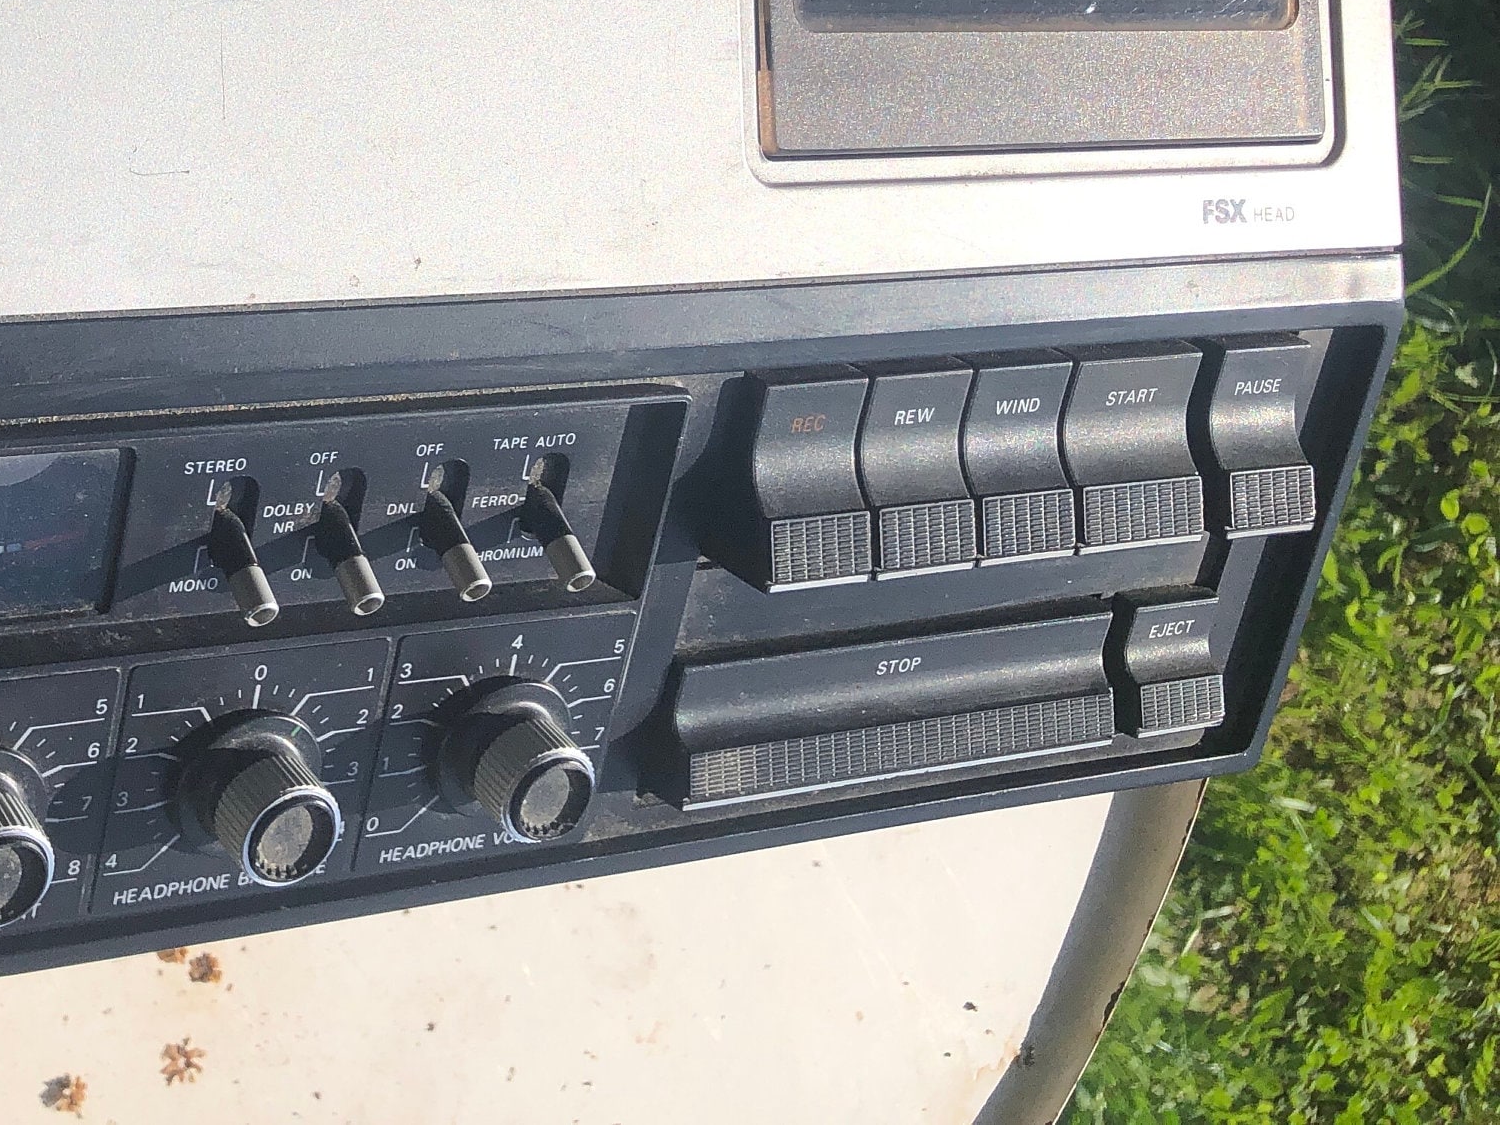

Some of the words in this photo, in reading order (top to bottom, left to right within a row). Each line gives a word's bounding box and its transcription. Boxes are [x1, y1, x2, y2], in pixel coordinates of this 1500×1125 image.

[1202, 199, 1248, 224] FSX
[1253, 206, 1295, 222] HEAD
[1234, 378, 1282, 396] PAUSE
[1105, 387, 1158, 406] START
[995, 396, 1040, 416] WIND
[791, 414, 825, 434] REC
[893, 407, 935, 426] REW
[493, 436, 529, 450] TAPE
[535, 432, 577, 448] AUTO
[309, 451, 339, 465] OFF
[416, 443, 444, 457] OFF
[184, 458, 247, 475] STEREO
[263, 502, 315, 518] DOLBY
[386, 503, 417, 516] DNL
[273, 521, 295, 534] NR
[476, 546, 544, 562] HROMIUM
[395, 558, 417, 571] ON
[290, 568, 313, 582] ON
[168, 577, 218, 593] MONO
[1148, 619, 1195, 639] EJECT
[511, 634, 524, 650] 4
[613, 638, 625, 654] 5
[254, 665, 268, 681] 0
[400, 663, 413, 678] 3
[876, 657, 921, 676] STOP
[603, 678, 615, 693] 6
[95, 698, 108, 714] 5
[390, 704, 404, 719] 2
[356, 709, 369, 725] 2
[594, 727, 605, 741] 7
[87, 742, 100, 758] 6
[125, 737, 138, 753] 2
[347, 761, 359, 776] 3
[81, 796, 93, 811] 7
[116, 791, 129, 807] 3
[365, 817, 380, 832] 0
[378, 832, 485, 864] HEADPHONE
[67, 860, 81, 875] 8
[105, 853, 118, 869] 4
[112, 873, 231, 906] HEADPHONE
